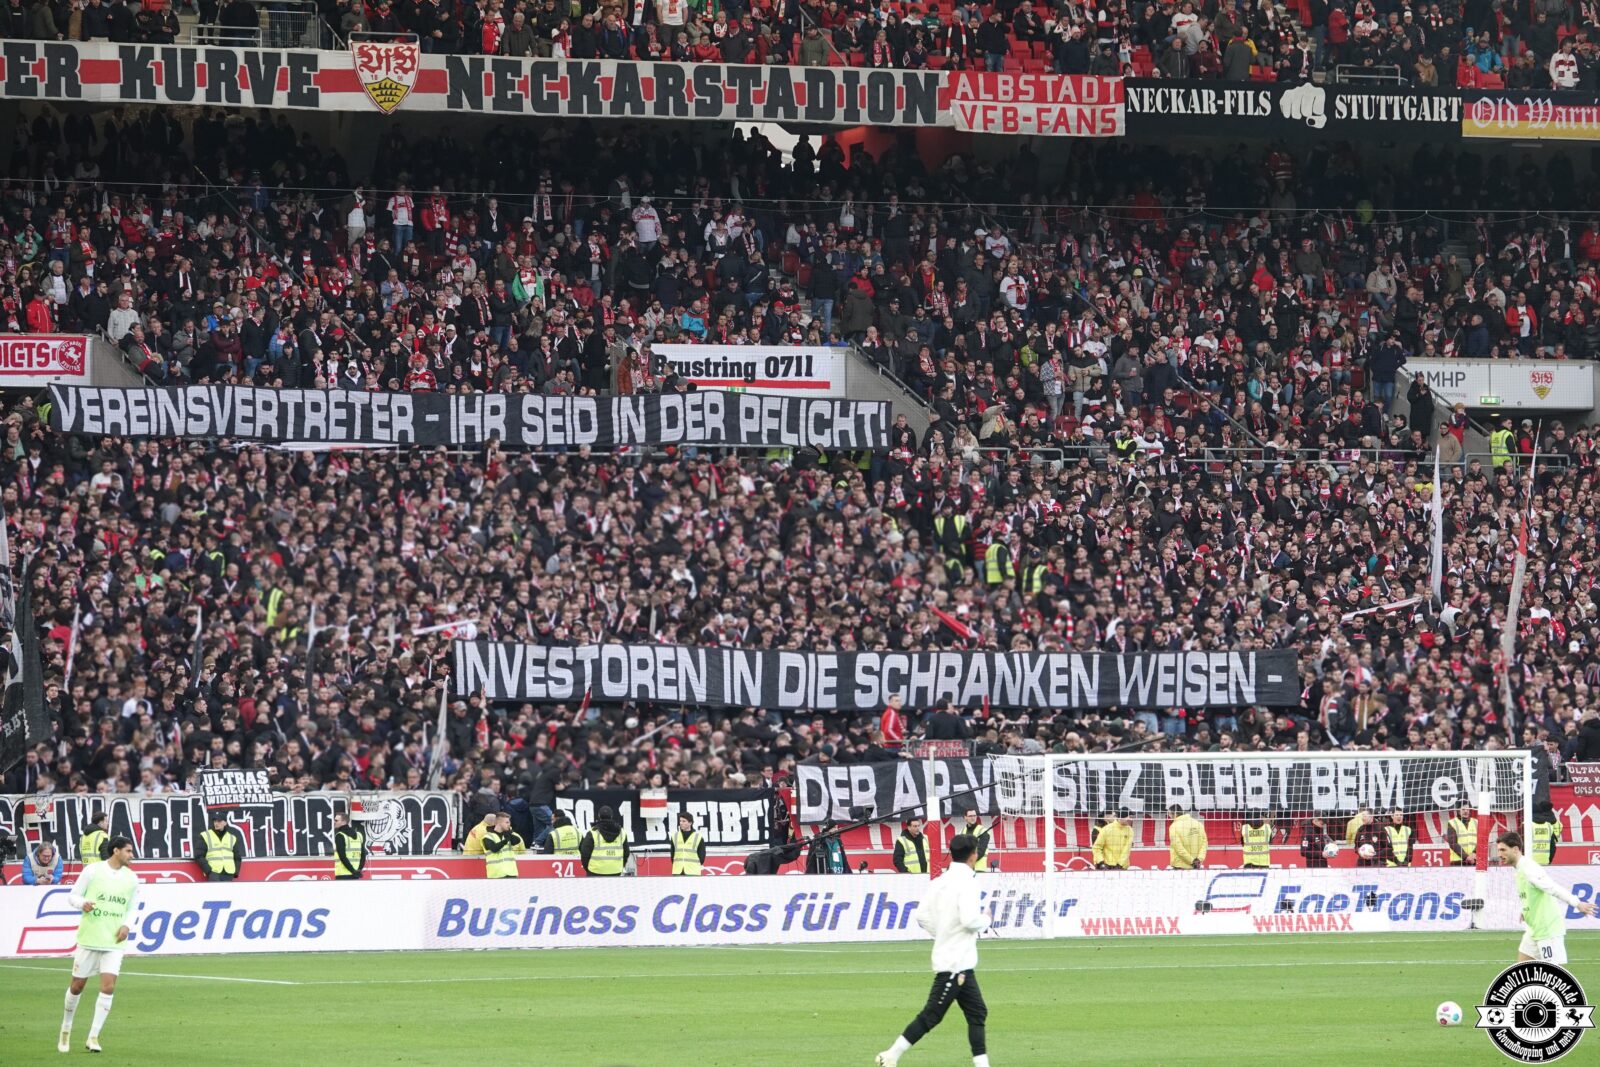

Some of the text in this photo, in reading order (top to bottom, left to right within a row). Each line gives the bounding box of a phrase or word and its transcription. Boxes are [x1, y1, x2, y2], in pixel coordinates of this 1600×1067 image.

[4, 42, 319, 107] ER KURVE
[446, 55, 939, 125] NECKARSTADION
[955, 73, 1123, 104] ALBSTADT
[1126, 87, 1462, 122] NECKAR-FILS STUTTGART
[1472, 96, 1518, 129] Old
[959, 103, 1117, 135] VFB-FANS
[0, 342, 50, 368] ICTS
[764, 355, 813, 378] 0711
[1427, 370, 1466, 387] MHP
[51, 384, 415, 443] VEREINSVERTRETER
[450, 394, 507, 443] IHR
[521, 394, 598, 446] SEID
[611, 396, 646, 444] IN
[660, 391, 726, 442] DER
[739, 394, 888, 447] PFLICHT!
[455, 640, 707, 702] INVESTOREN
[723, 650, 763, 707] IN
[778, 652, 838, 708] DIE
[854, 652, 1099, 708] SCHRANKEN
[1116, 651, 1257, 706] WEISEN
[202, 770, 269, 787] ULTRAS
[204, 784, 270, 796] BEDEUTET
[796, 764, 878, 823] DER
[1161, 760, 1294, 811] BLEIBT
[1310, 758, 1405, 810] BEIM
[206, 793, 273, 805] WIDERSTAND
[551, 861, 576, 877] 34
[1421, 850, 1444, 867] 35
[437, 896, 640, 938] Business
[652, 893, 772, 934] Class
[782, 892, 852, 931] für
[980, 890, 1078, 928] üter
[1080, 916, 1181, 935] WINAMAX
[1253, 914, 1354, 932] WINAMAX
[1542, 945, 1553, 959] 20
